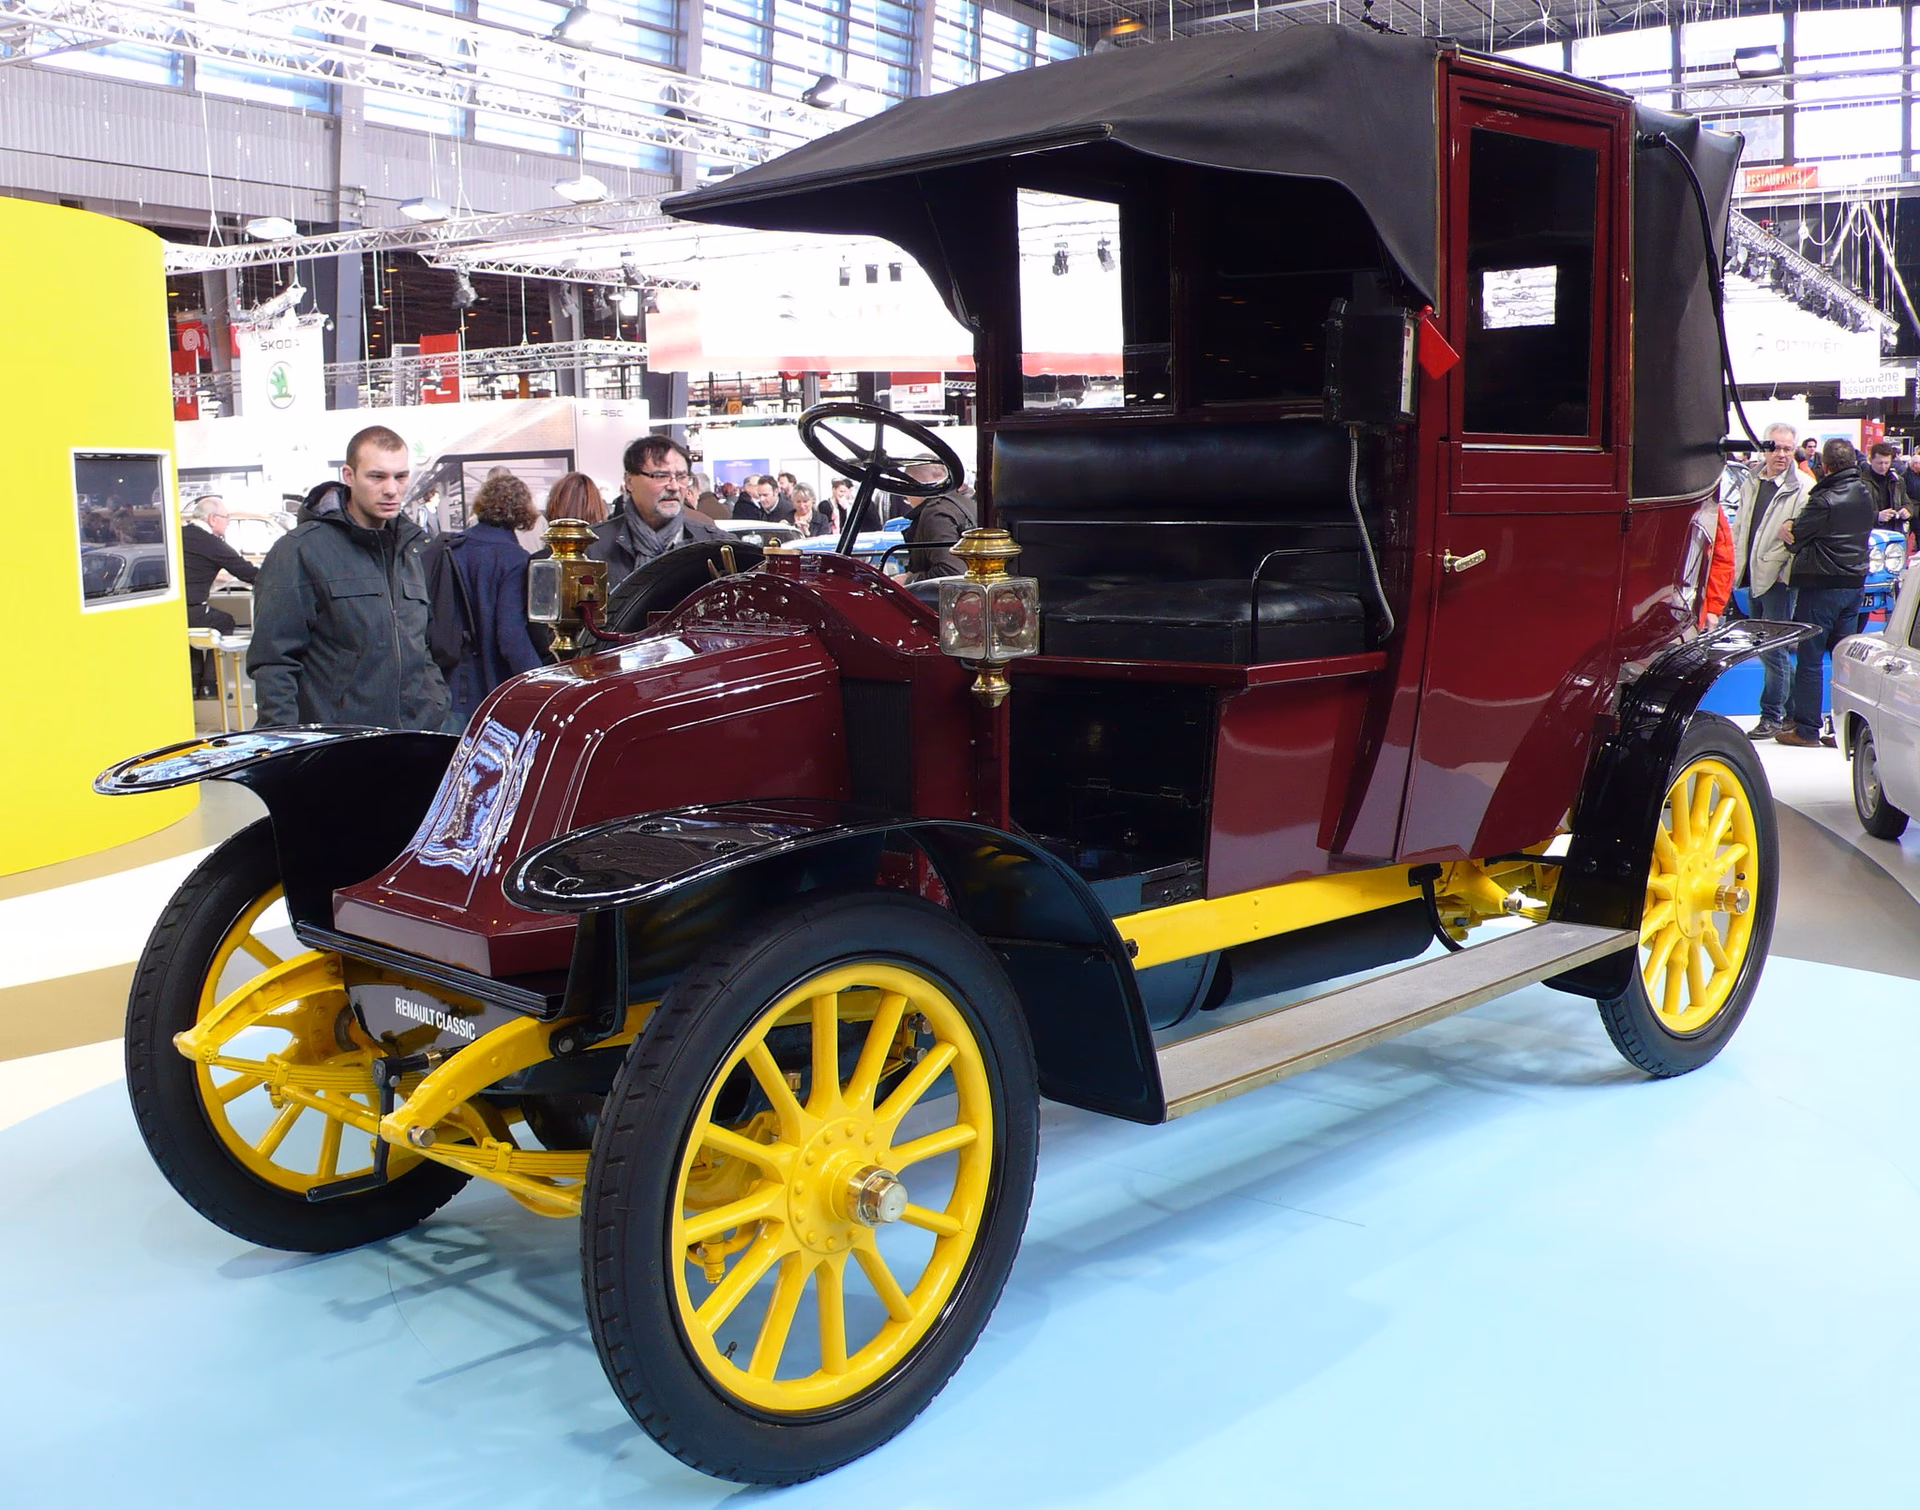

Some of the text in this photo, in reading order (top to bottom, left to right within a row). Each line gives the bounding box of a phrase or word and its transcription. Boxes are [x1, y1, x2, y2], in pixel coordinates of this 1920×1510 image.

[1746, 171, 1802, 188] RESTAURANTS
[1842, 383, 1899, 395] assurances
[1845, 640, 1874, 662] REIMS
[395, 996, 476, 1041] RENAULT CLASSIC
